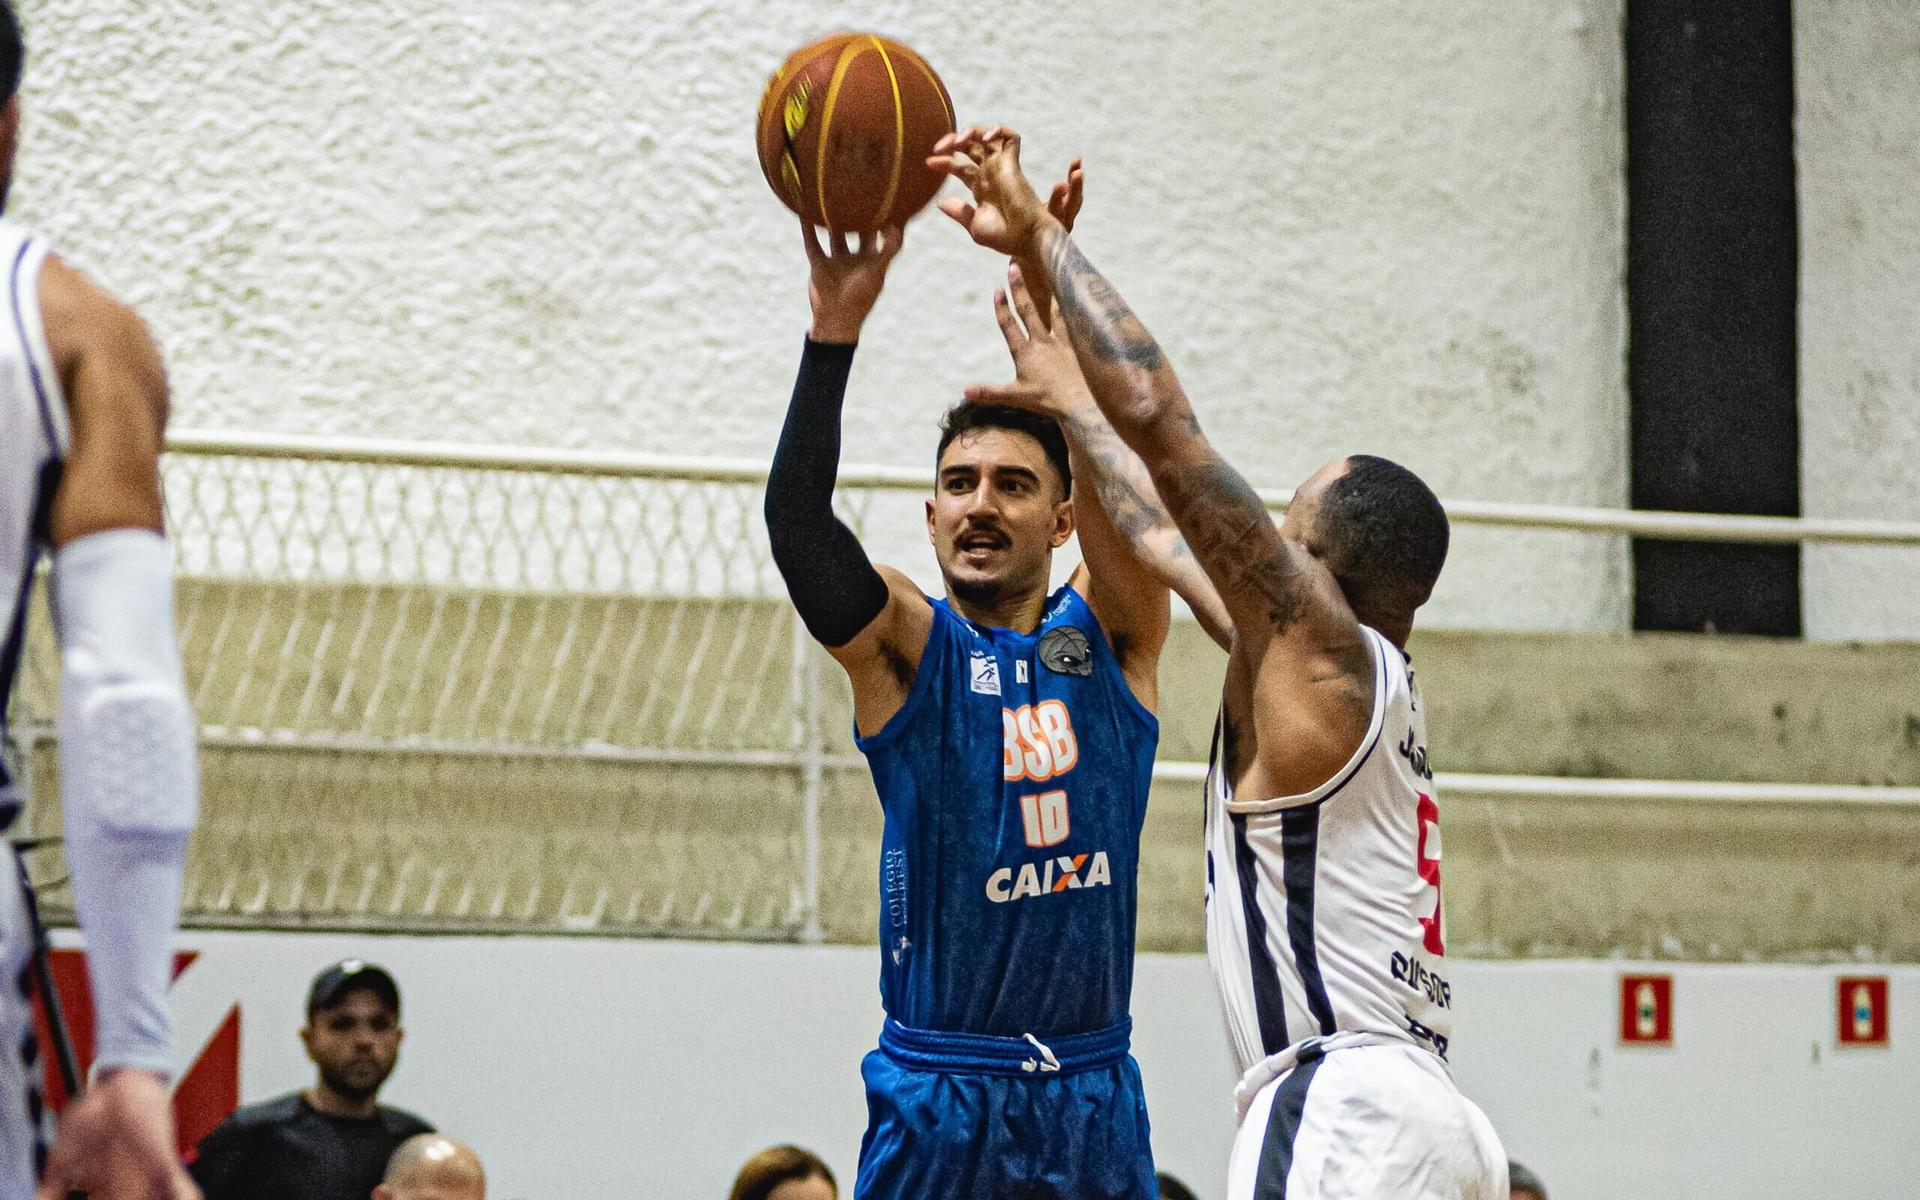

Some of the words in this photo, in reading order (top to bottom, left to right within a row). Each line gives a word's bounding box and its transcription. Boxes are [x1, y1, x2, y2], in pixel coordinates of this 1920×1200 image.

[1002, 699, 1078, 782] BSB
[1020, 789, 1070, 847] 10
[985, 851, 1112, 903] CAIXA
